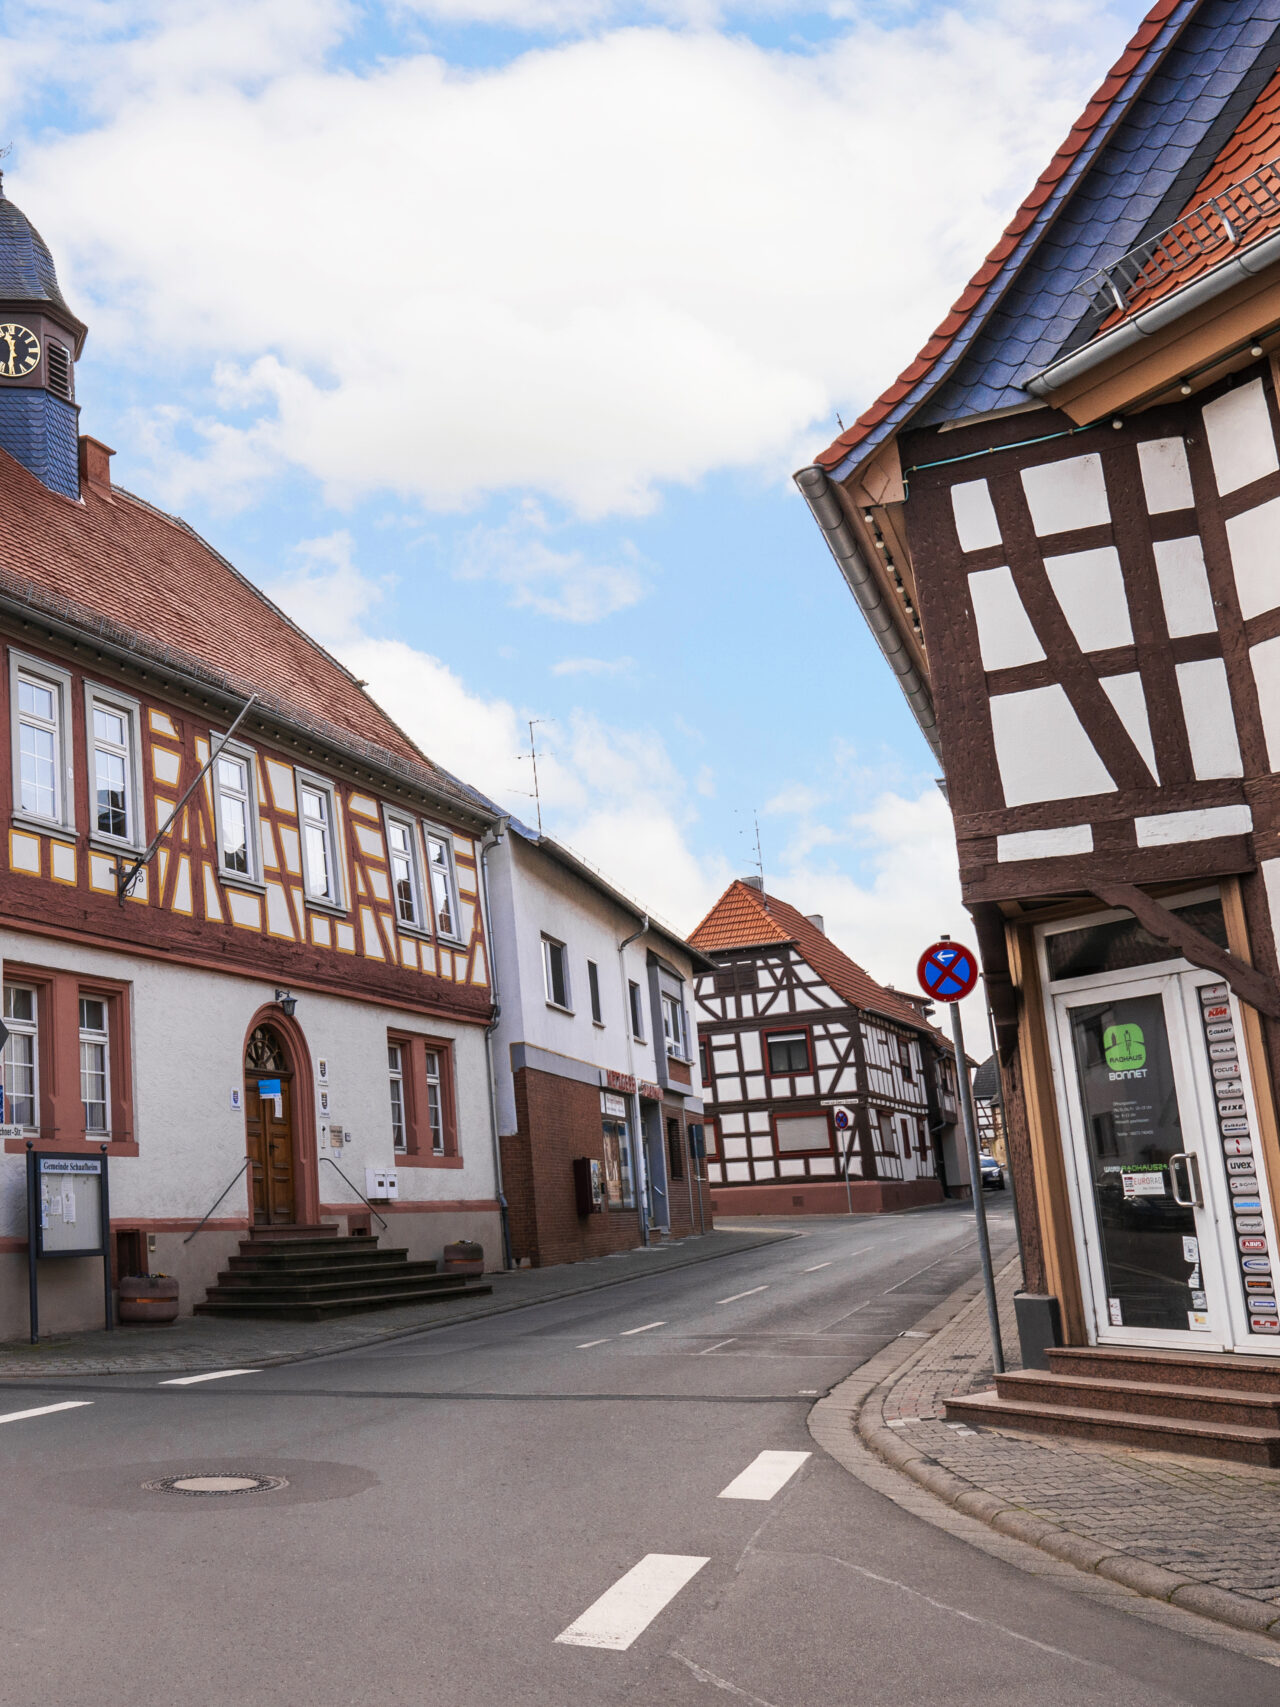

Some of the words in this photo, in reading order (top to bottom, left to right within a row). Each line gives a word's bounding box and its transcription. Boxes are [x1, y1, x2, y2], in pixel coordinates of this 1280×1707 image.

[1208, 1007, 1228, 1017] KTM
[1109, 1054, 1143, 1063] RADHAUS
[43, 1161, 69, 1171] Gemeinde
[1230, 1161, 1252, 1170] uvex
